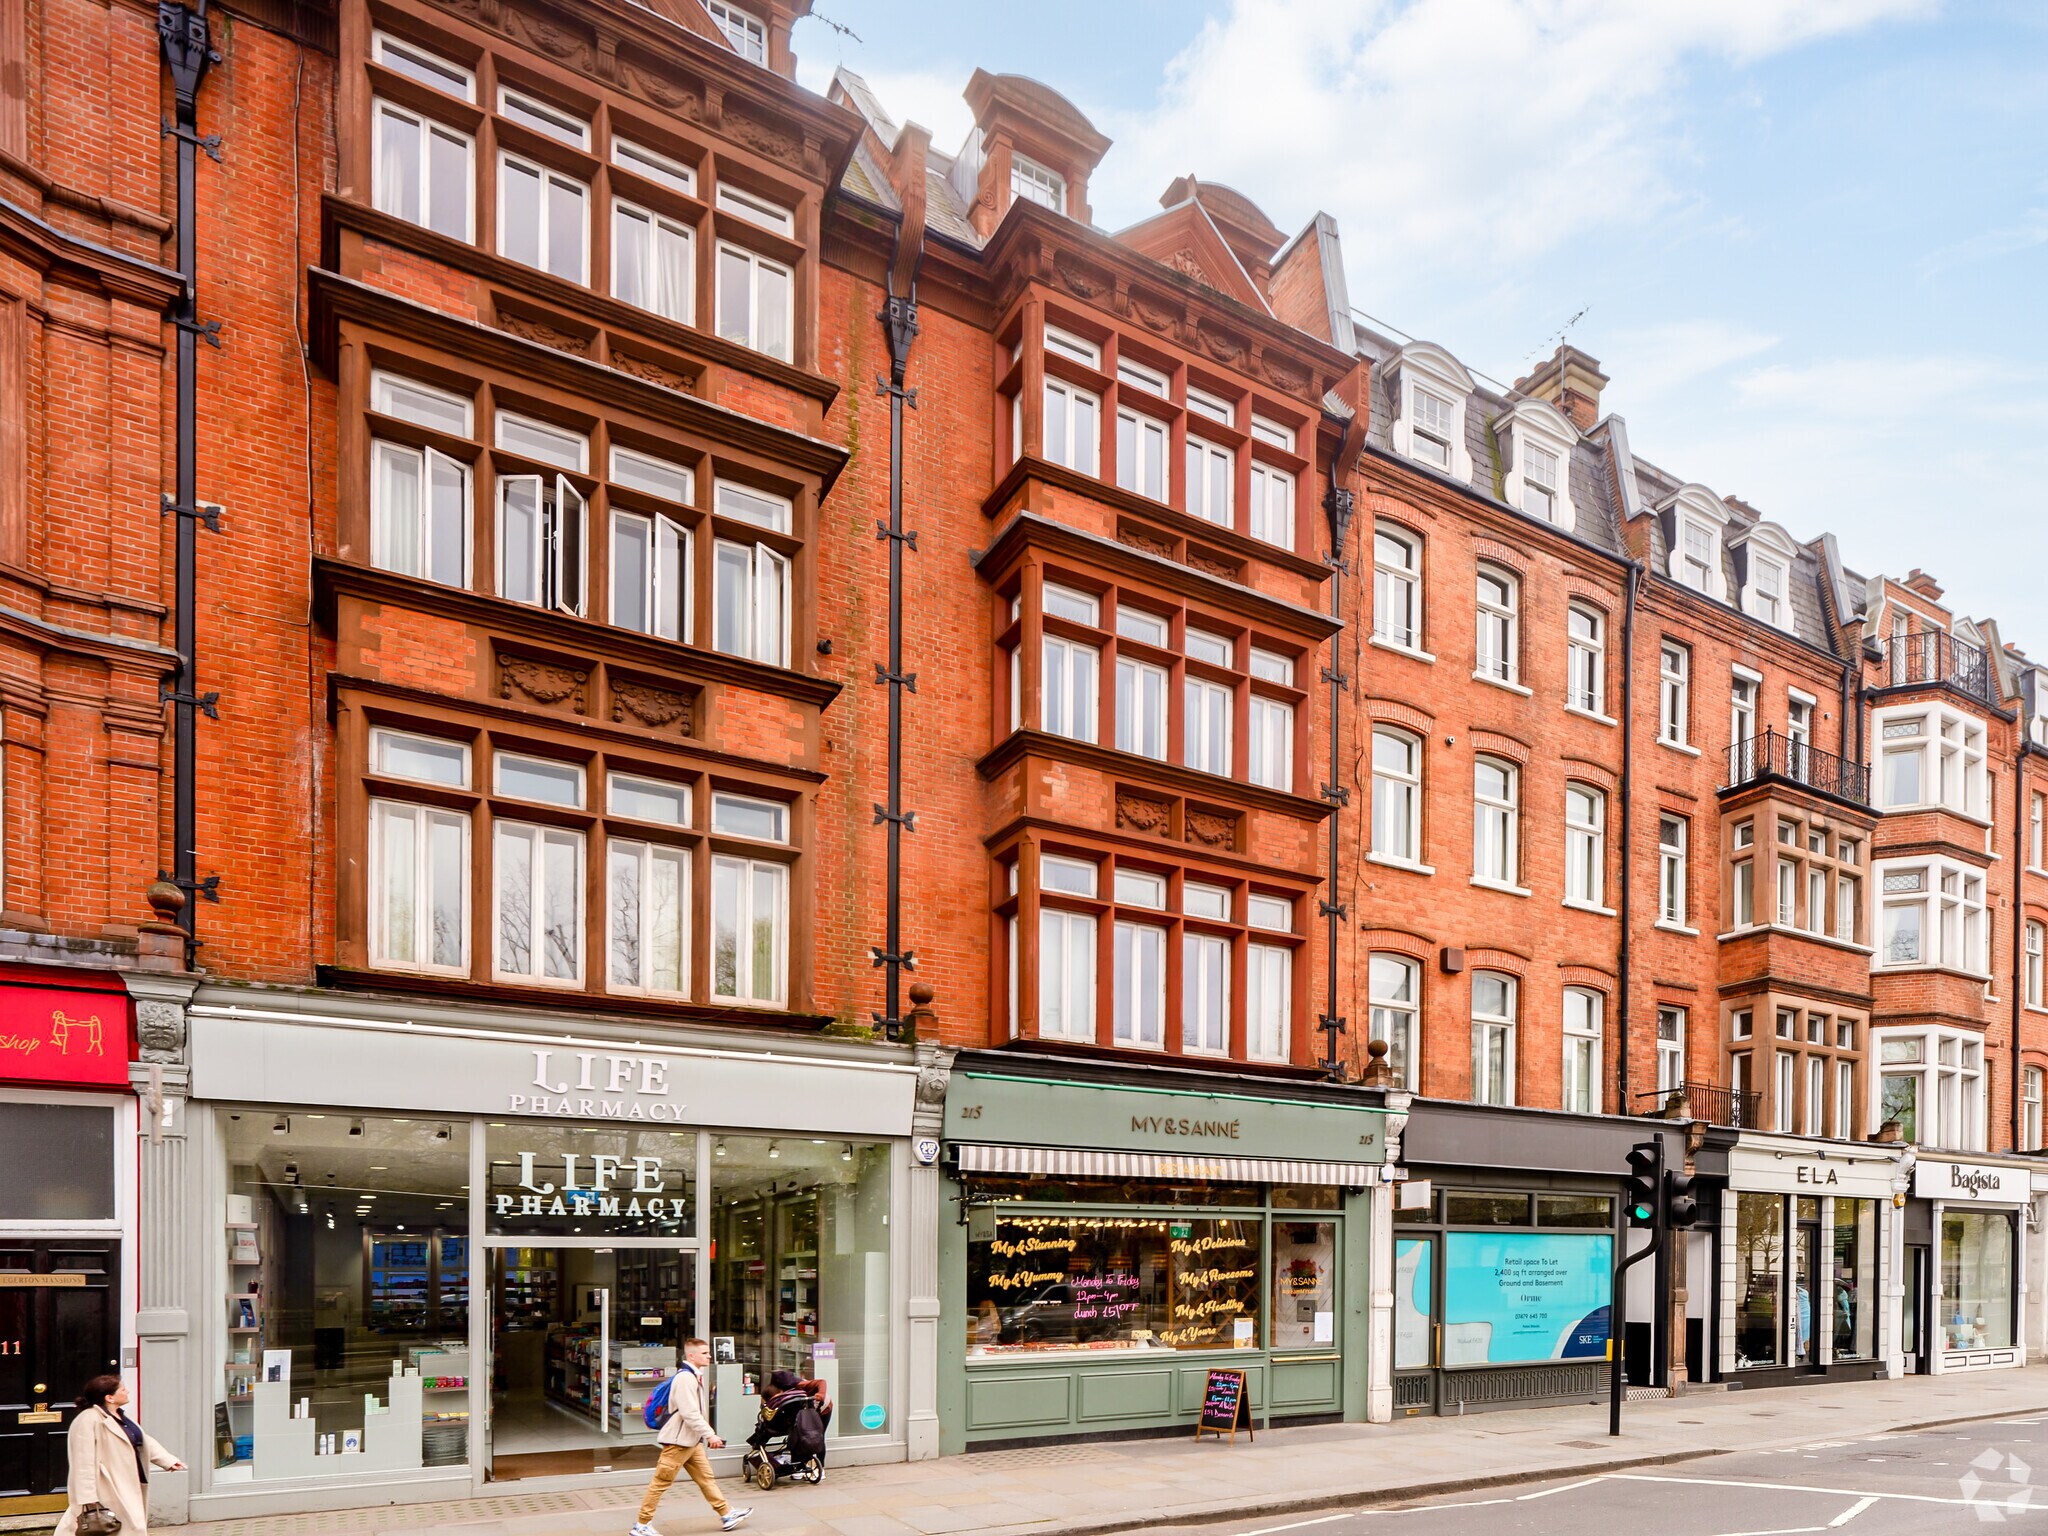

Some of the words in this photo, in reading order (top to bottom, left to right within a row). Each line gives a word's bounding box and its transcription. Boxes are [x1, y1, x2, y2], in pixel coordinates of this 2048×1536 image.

[532, 1050, 669, 1095] LIFE
[508, 1094, 687, 1121] PHARMACY
[961, 1105, 983, 1119] 215
[1131, 1115, 1240, 1140] MY&SANNÉ
[1358, 1133, 1374, 1145] 215
[517, 1151, 666, 1195] LIFE
[1797, 1166, 1839, 1185] ELA
[1951, 1165, 2000, 1198] Bagista
[495, 1194, 686, 1218] PHARMACY
[42, 1276, 82, 1284] MANSIONS
[1494, 1268, 1512, 1277] 2,400
[1521, 1268, 1527, 1276] ft
[1528, 1269, 1555, 1277] arranged
